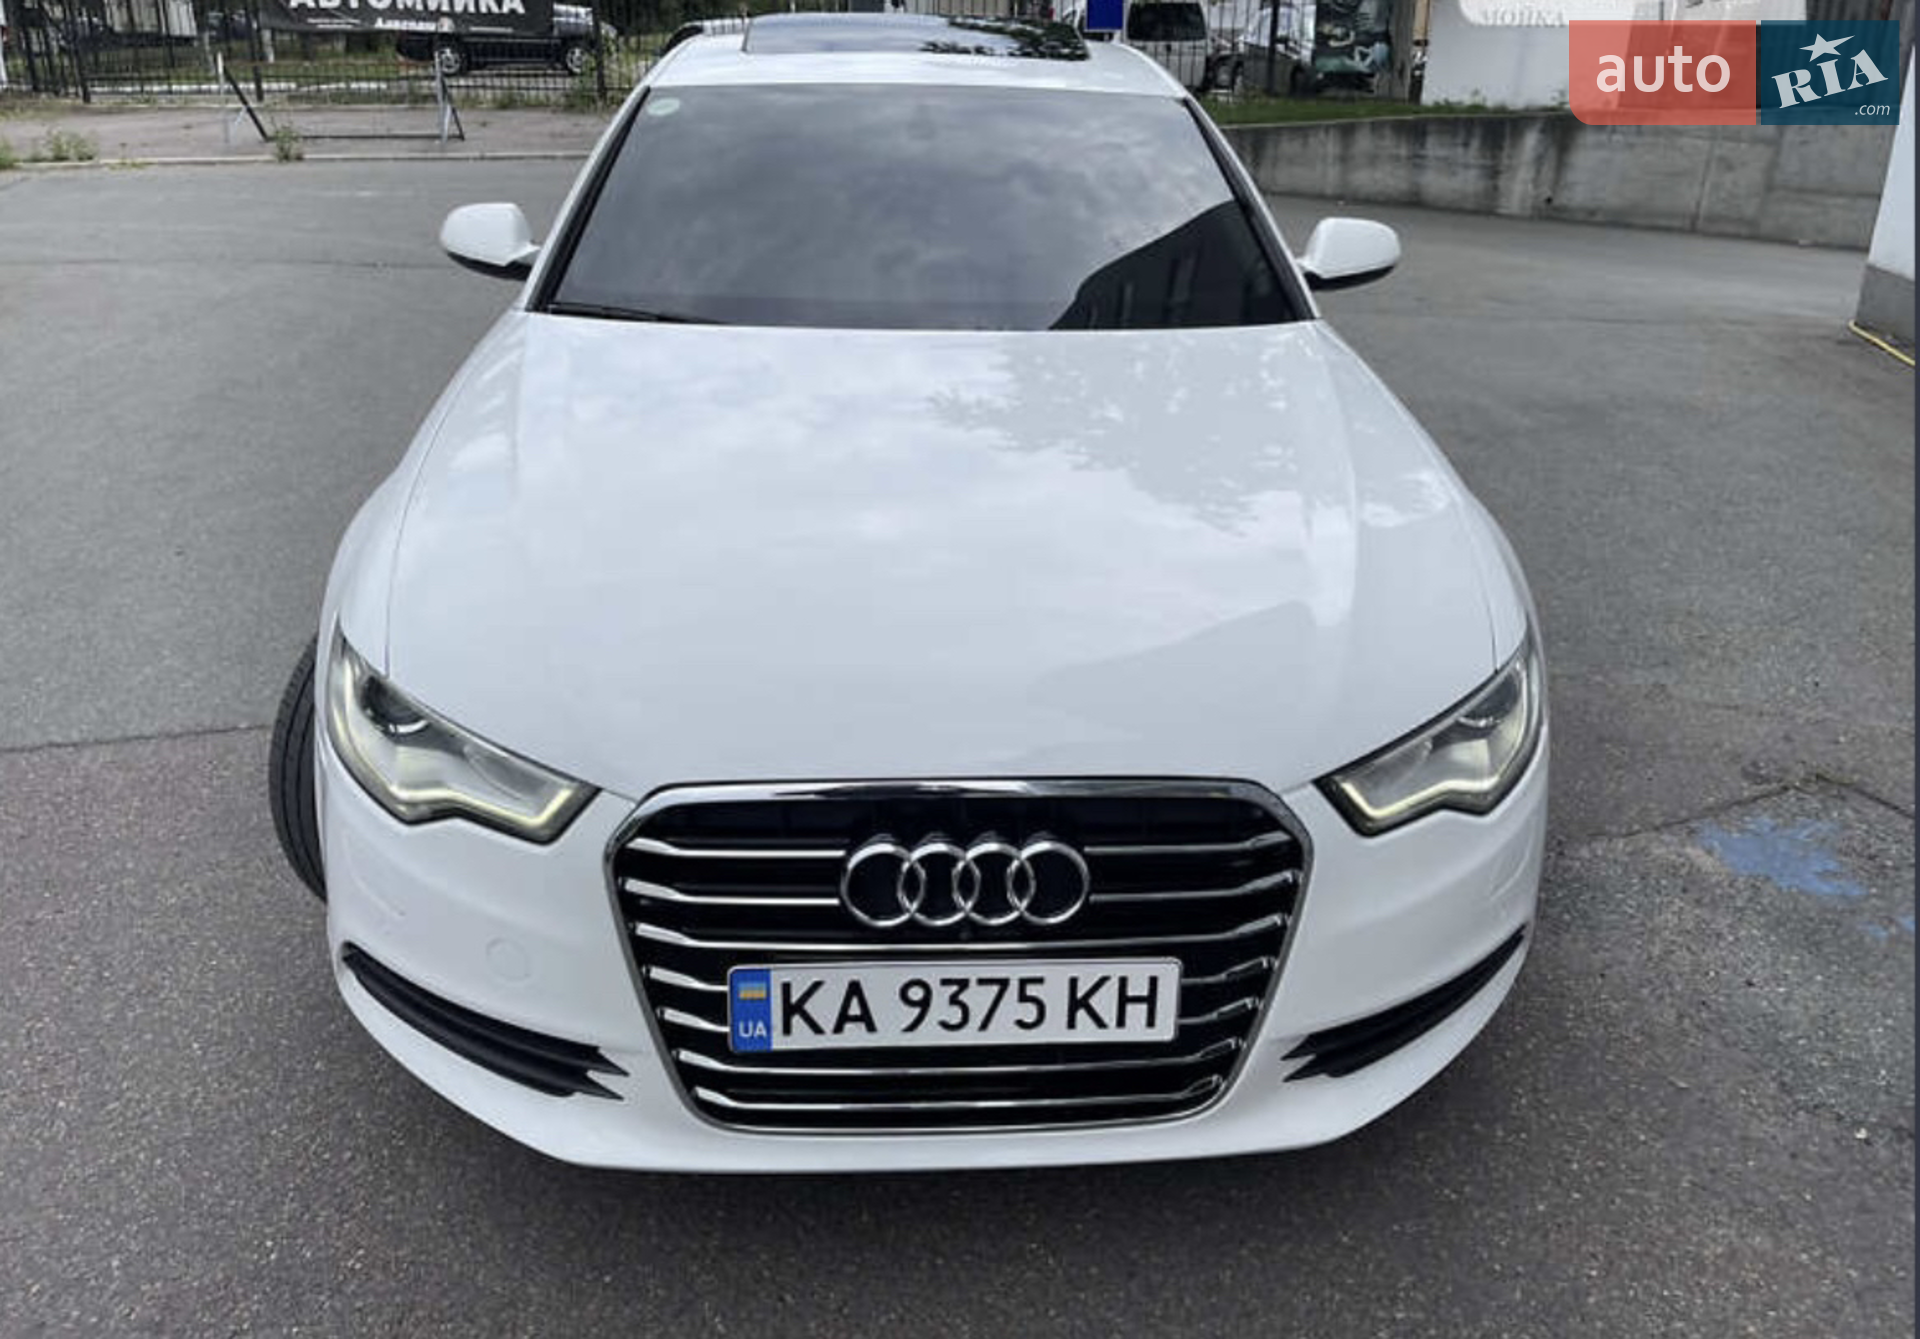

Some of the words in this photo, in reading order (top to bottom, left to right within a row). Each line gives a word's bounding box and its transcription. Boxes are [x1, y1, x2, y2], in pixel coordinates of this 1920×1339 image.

[780, 980, 877, 1036] KA
[900, 977, 1046, 1032] 9375
[1066, 976, 1158, 1030] KH
[738, 1020, 767, 1039] UA
